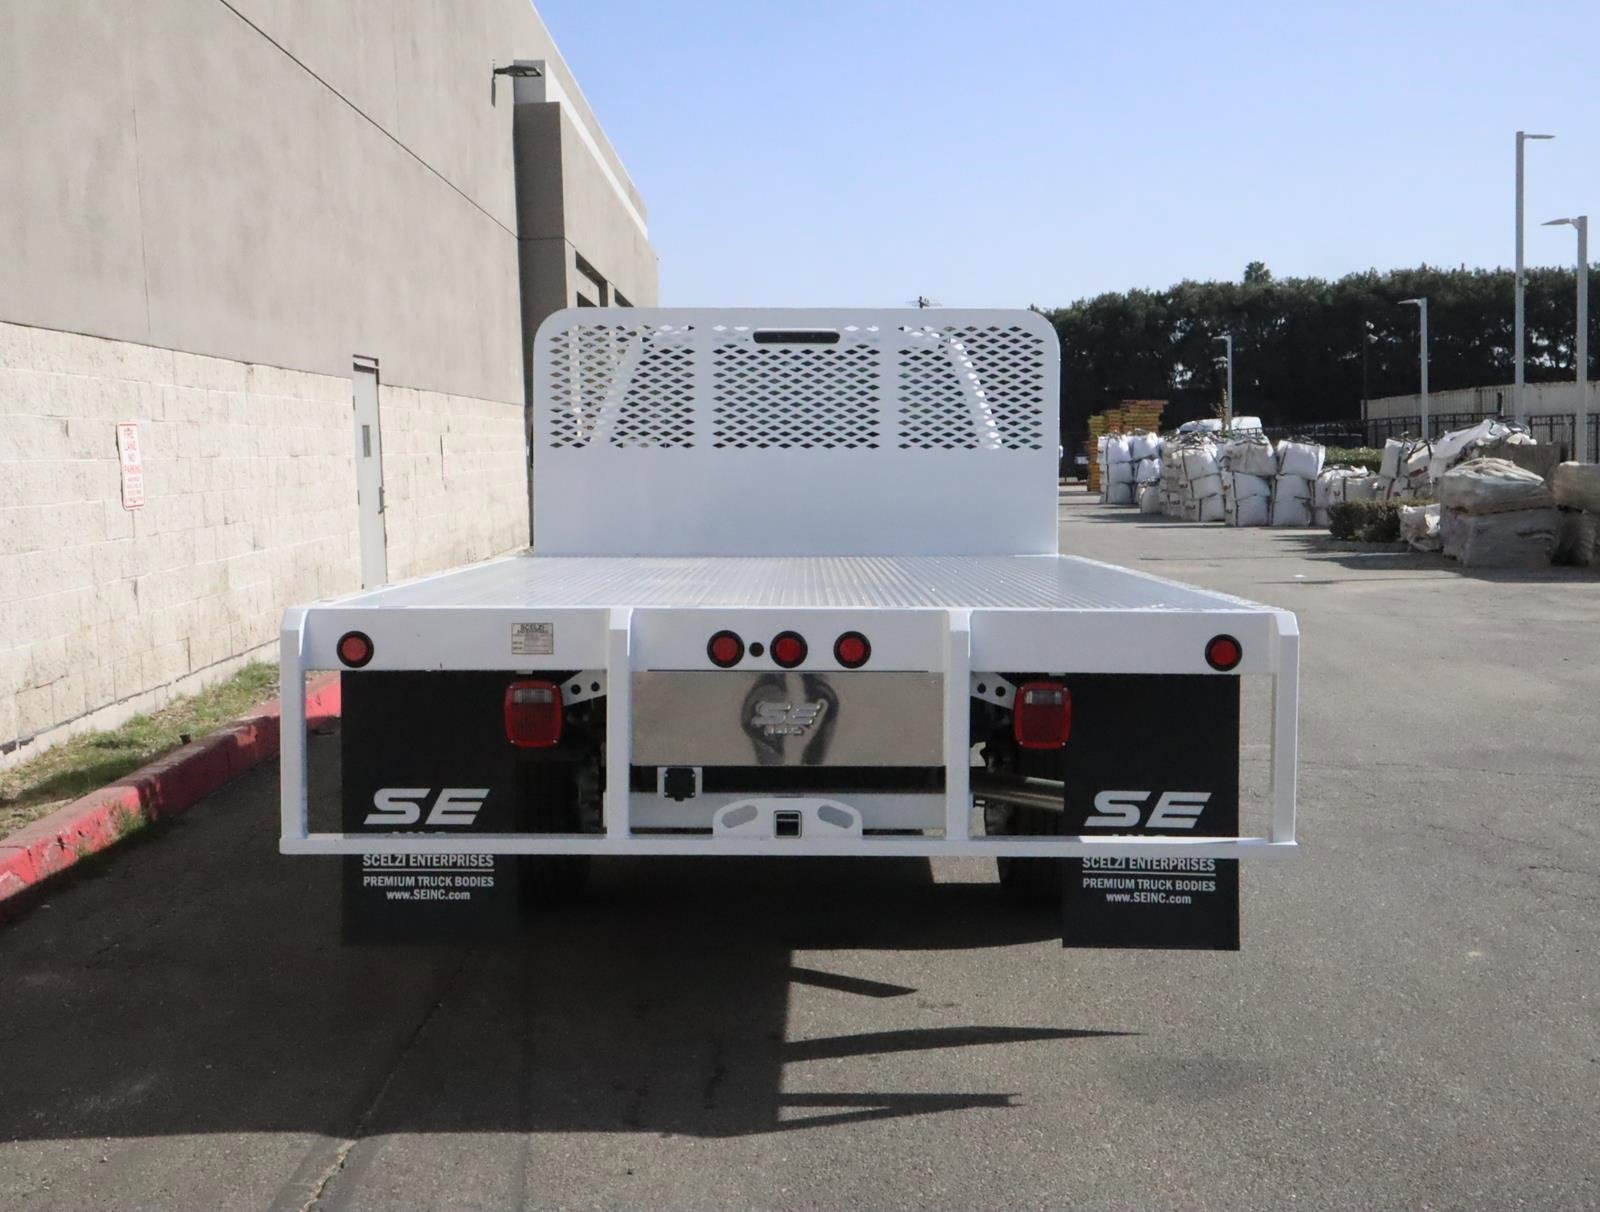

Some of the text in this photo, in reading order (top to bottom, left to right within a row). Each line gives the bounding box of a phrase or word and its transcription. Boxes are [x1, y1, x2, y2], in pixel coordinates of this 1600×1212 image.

[751, 702, 820, 727] SE
[363, 788, 490, 825] SE
[1084, 790, 1211, 829] SE
[362, 854, 494, 867] SCELZI ENTERPRISES
[1082, 857, 1216, 871] SCELZI ENTERPRISES
[363, 876, 494, 888] PREMIUM TRUCK BODIES
[1082, 878, 1216, 892] PREMIUM TRUCK BODIES
[386, 889, 471, 900] www.SEINC.com
[1106, 892, 1192, 904] www.SEINC.com
